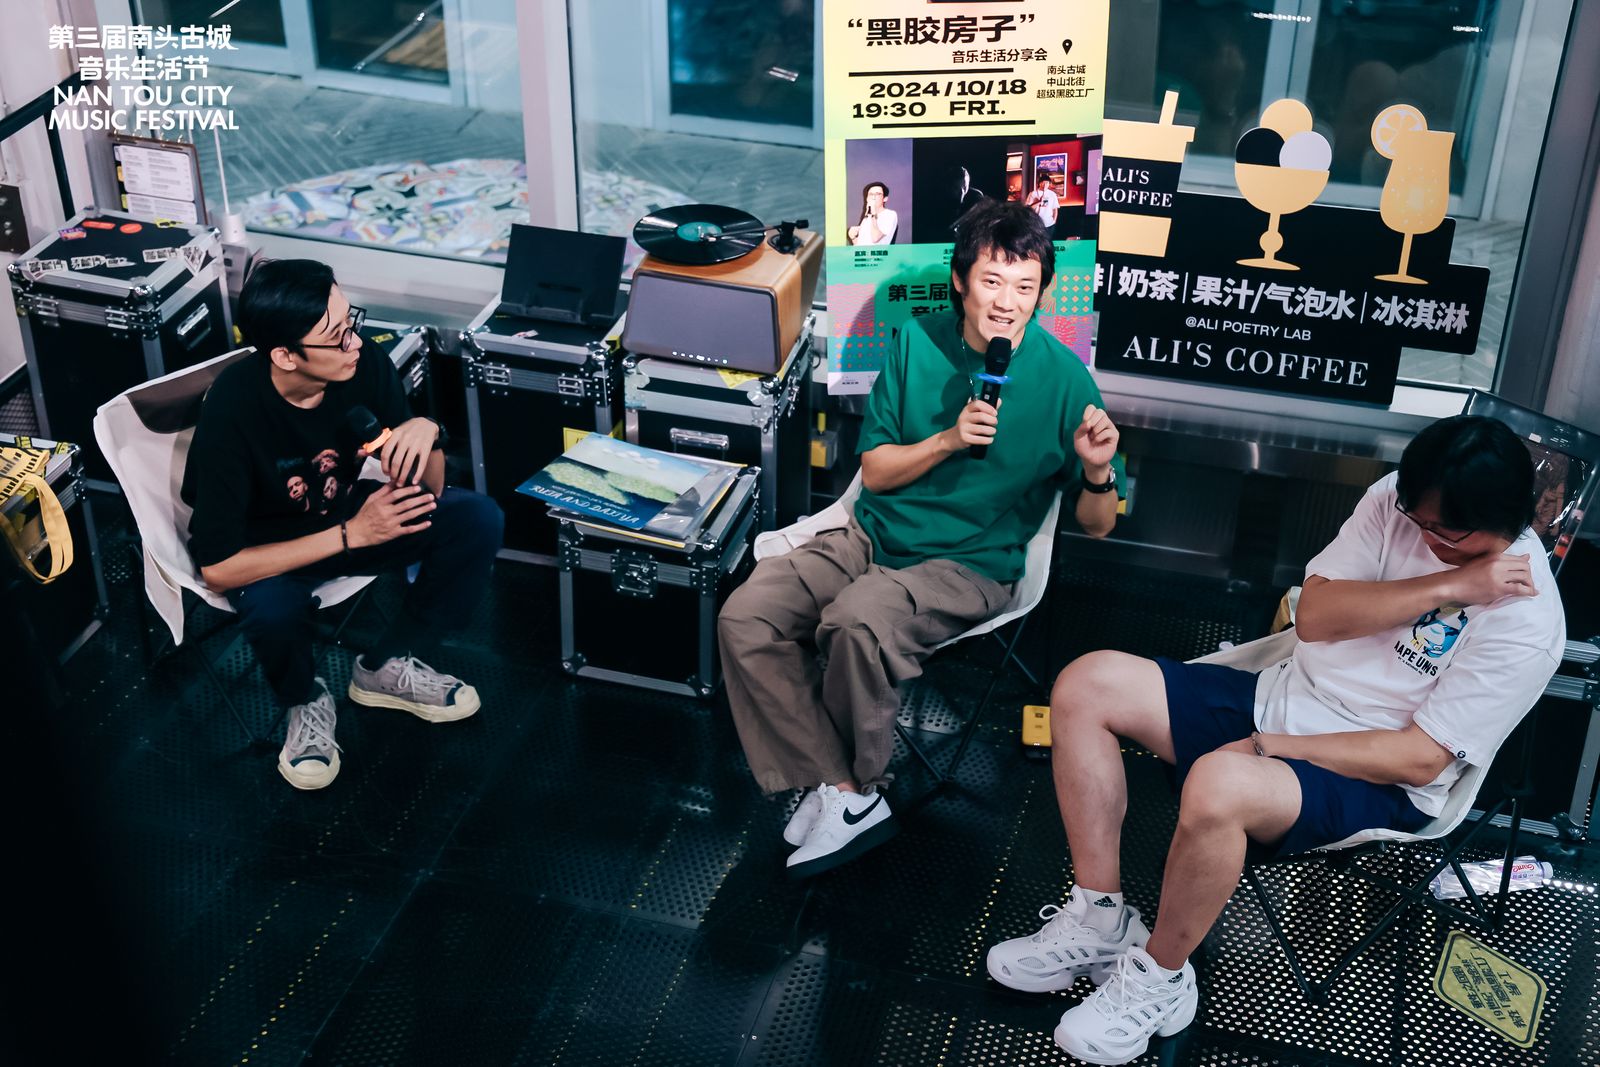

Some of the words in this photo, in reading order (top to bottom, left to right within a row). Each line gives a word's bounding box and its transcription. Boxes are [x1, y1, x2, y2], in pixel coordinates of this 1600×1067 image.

[951, 48, 1048, 64] 音乐生活分享会
[1046, 65, 1087, 75] 南头古城
[1046, 76, 1086, 87] 中山北街
[1036, 88, 1095, 99] 超级黑胶工厂
[852, 101, 927, 119] 19:30
[949, 100, 1006, 116] FRI.
[1103, 167, 1150, 185] ALI'S
[1101, 187, 1173, 208] COFFEE
[1185, 316, 1218, 331] @ALI
[1222, 320, 1281, 338] POETRY
[1283, 326, 1312, 342] LAB
[1122, 336, 1213, 368] ALI'S
[1225, 347, 1369, 387] COFFEE
